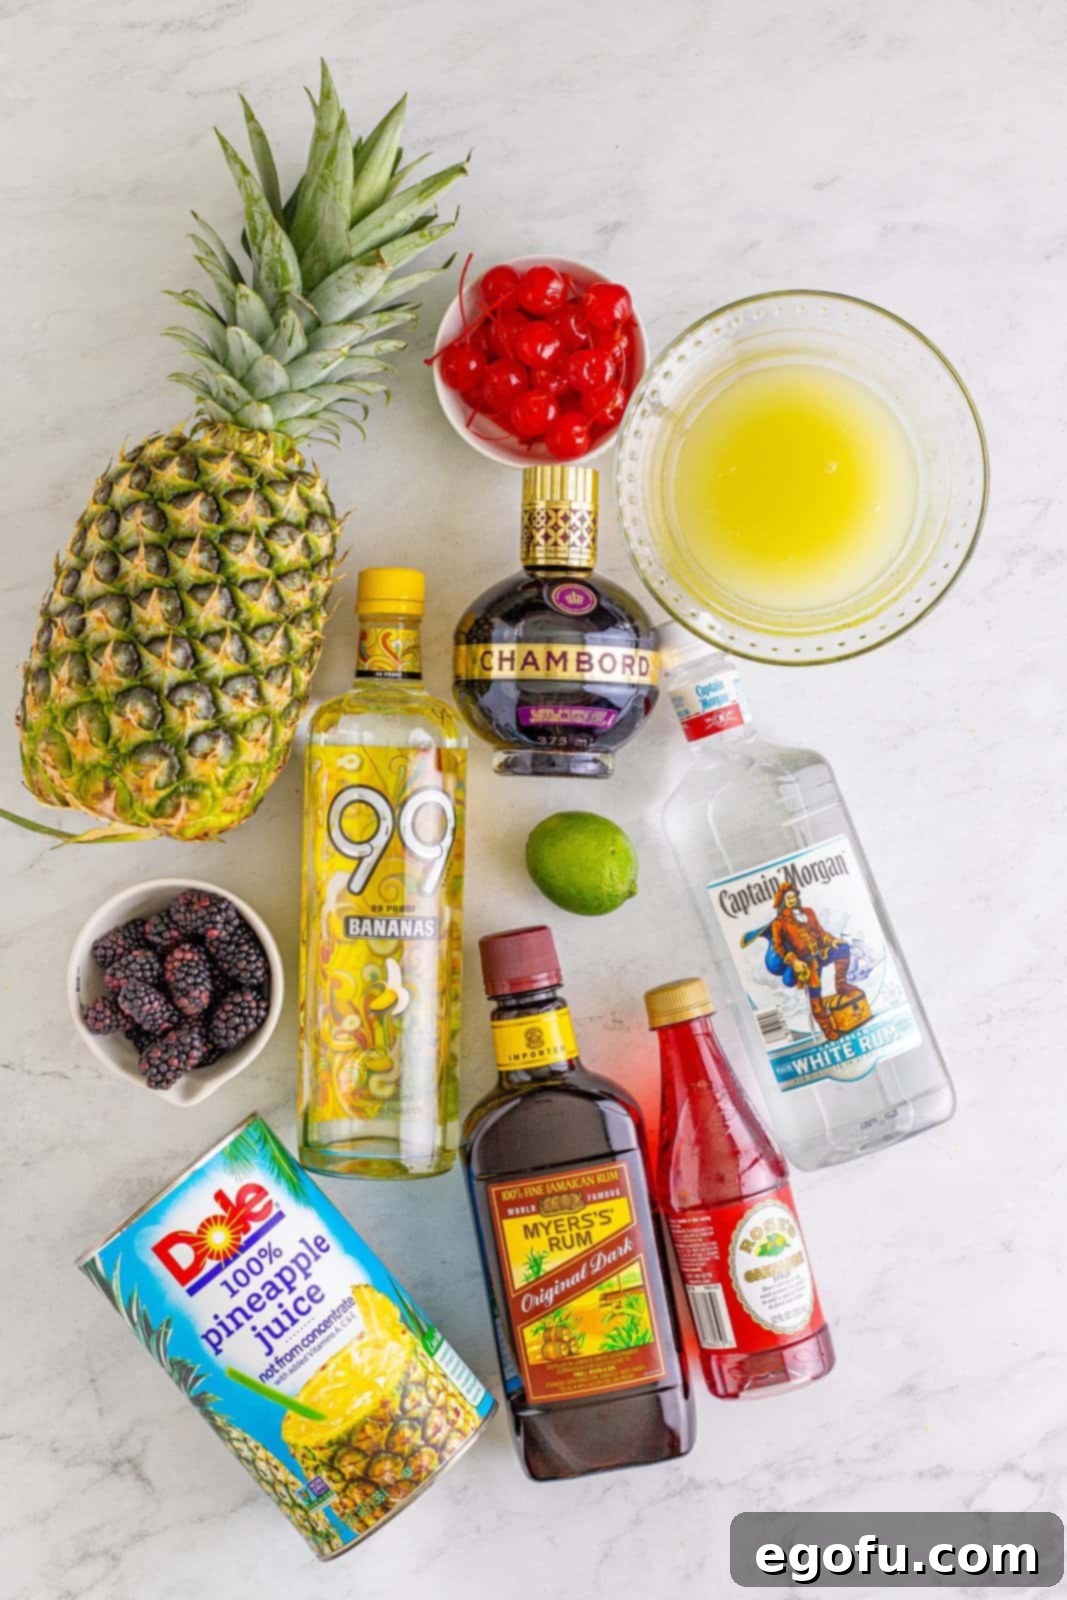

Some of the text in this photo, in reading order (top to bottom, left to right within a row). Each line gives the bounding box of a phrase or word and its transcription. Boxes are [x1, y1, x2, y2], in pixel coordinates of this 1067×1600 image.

[480, 649, 650, 677] CHAMBORD
[327, 784, 457, 895] 99
[719, 854, 848, 919] Captain Morgan
[348, 918, 434, 938] BANANAS
[508, 1045, 566, 1062] IMPORTED
[792, 1042, 856, 1075] WHITE
[860, 1023, 897, 1052] RUM
[523, 1183, 545, 1198] FINE
[545, 1175, 596, 1194] JAMAICAN
[597, 1170, 620, 1184] RUM
[151, 1182, 273, 1287] Dole
[523, 1209, 613, 1240] MYERS'S
[548, 1230, 594, 1253] RUM
[201, 1234, 331, 1356] pineapple
[220, 1241, 283, 1298] 100%
[520, 1262, 588, 1314] Original
[590, 1236, 634, 1276] Dark
[250, 1283, 325, 1356] juice
[258, 1297, 356, 1384] not from concentrate
